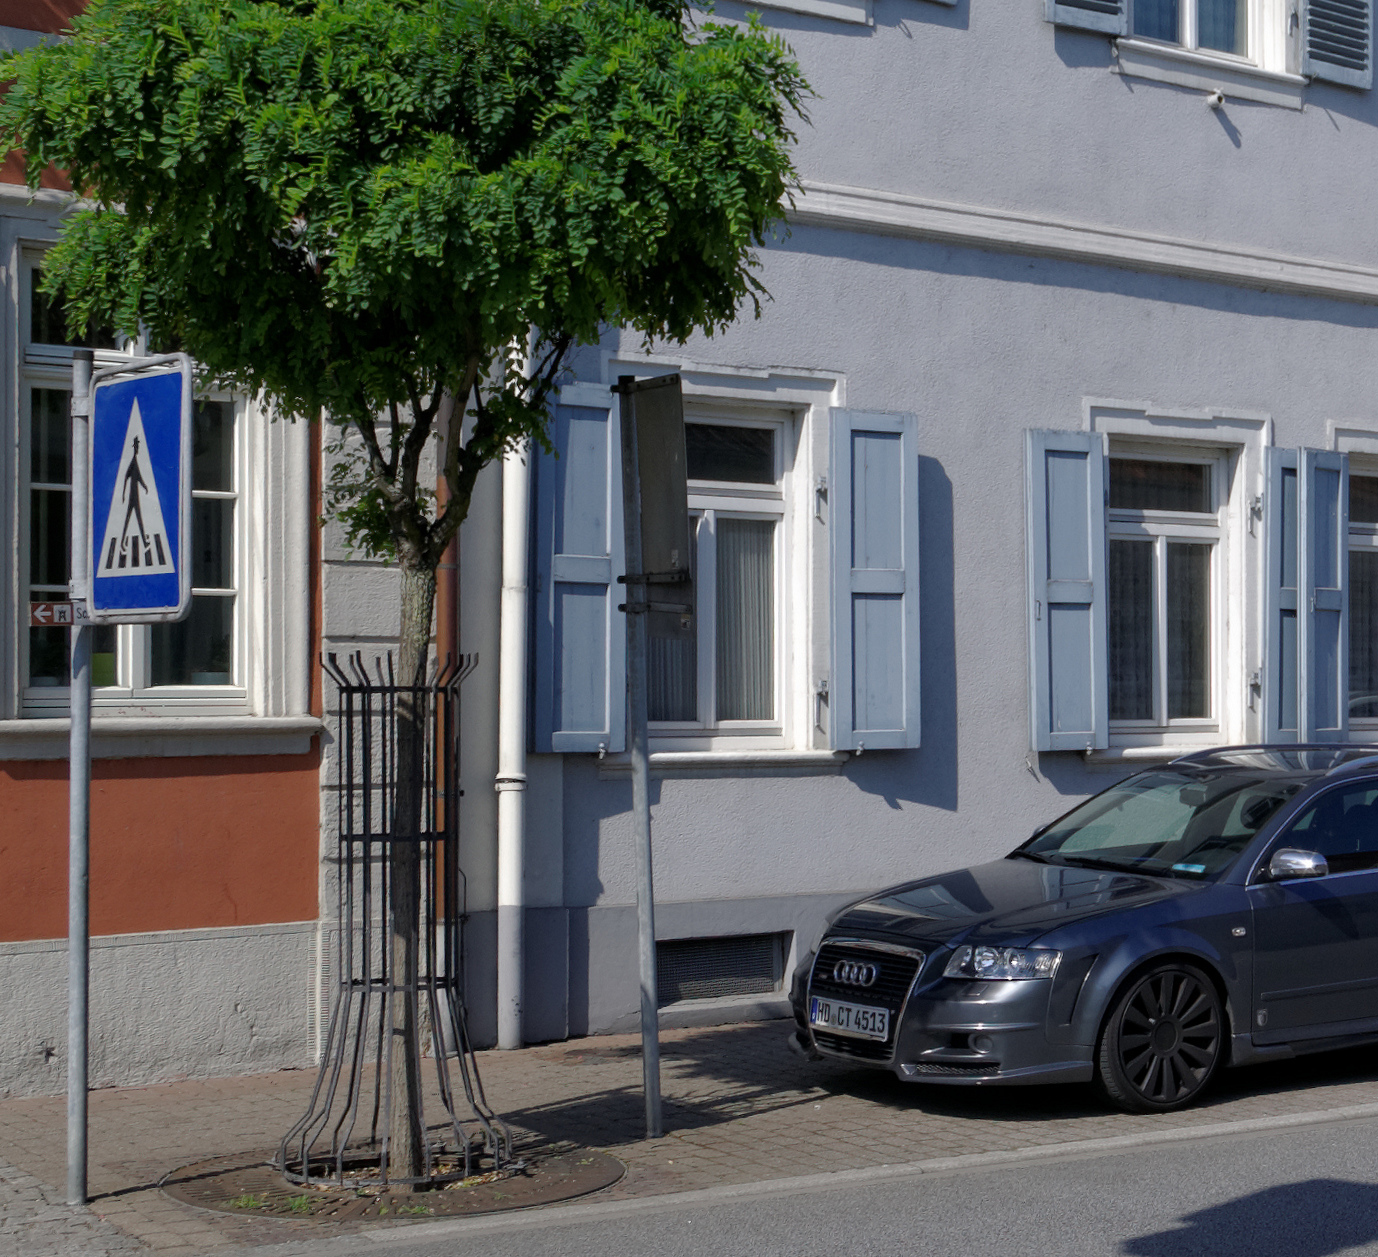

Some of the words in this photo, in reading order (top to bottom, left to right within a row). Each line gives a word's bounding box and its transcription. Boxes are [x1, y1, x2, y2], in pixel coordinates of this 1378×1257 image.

[817, 1002, 831, 1023] HD
[837, 1006, 852, 1028] CT
[855, 1009, 886, 1033] 4513
